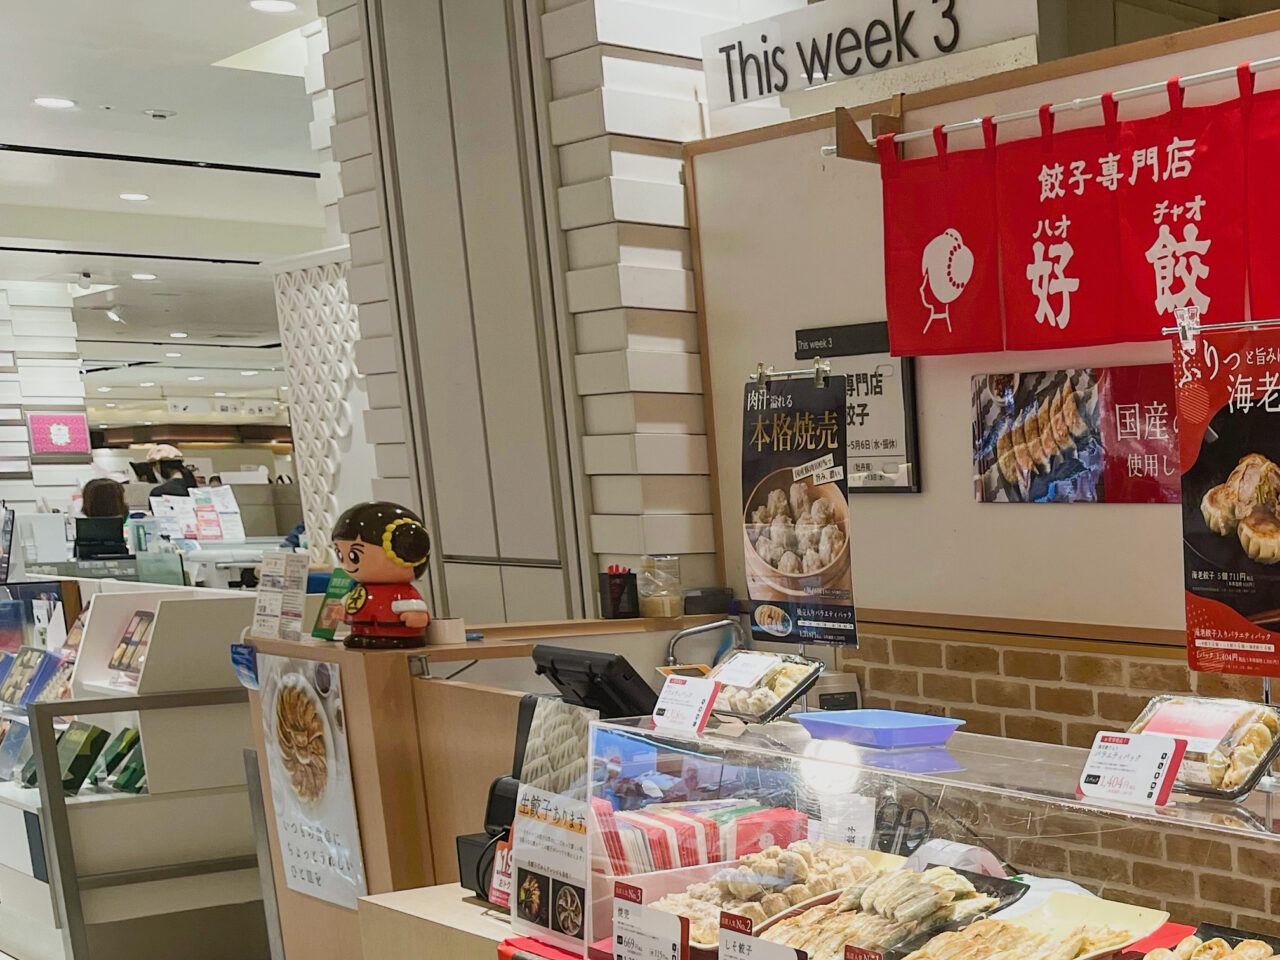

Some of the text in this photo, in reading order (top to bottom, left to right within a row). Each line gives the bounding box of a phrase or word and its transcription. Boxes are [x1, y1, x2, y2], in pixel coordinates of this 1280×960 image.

[719, 0, 960, 102] This week 3
[1038, 137, 1196, 202] 餃子専門店
[1033, 214, 1071, 238] ハオ
[1153, 195, 1206, 223] チャオ
[797, 337, 833, 350] This week 3
[750, 411, 839, 452] 本格焼売
[1115, 401, 1180, 442] 国産
[725, 940, 752, 955] しそ餃子
